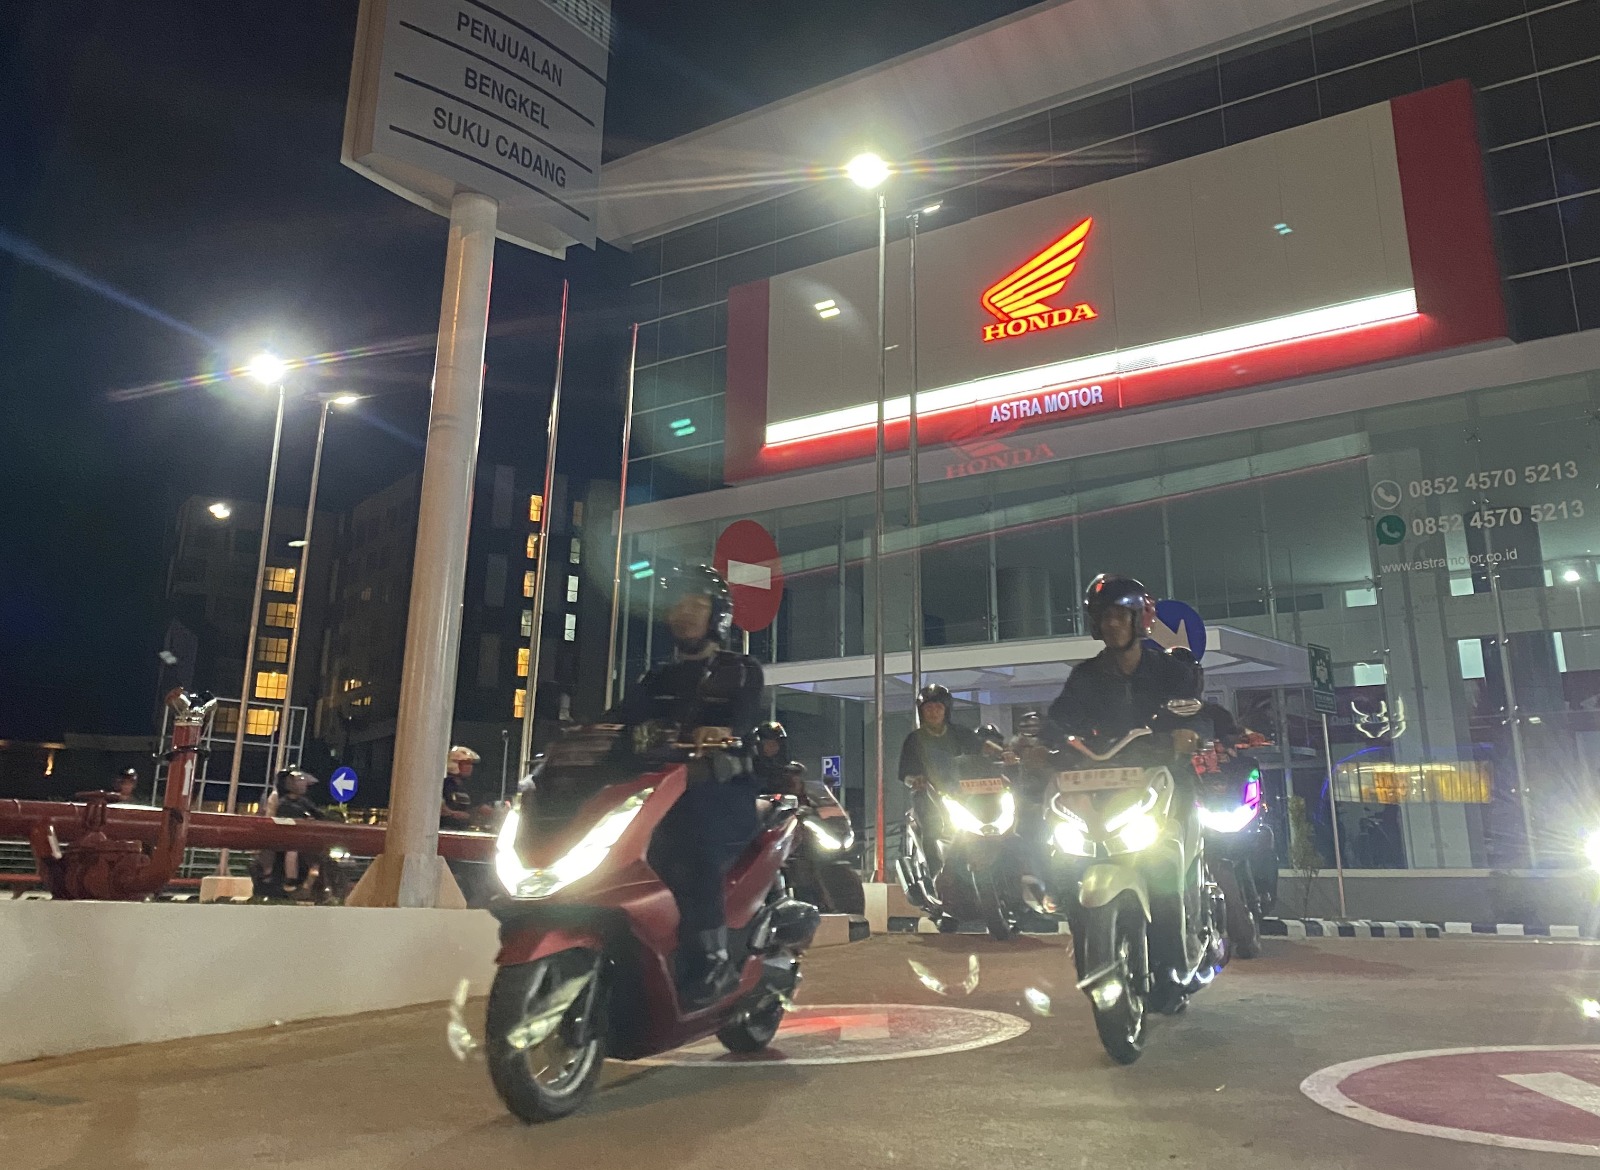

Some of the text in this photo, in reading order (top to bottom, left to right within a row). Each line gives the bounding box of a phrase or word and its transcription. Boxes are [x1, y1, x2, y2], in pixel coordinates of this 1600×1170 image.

[457, 11, 563, 87] PENJUALAN
[464, 67, 550, 130] BENGKEL
[433, 107, 566, 189] SUKU CADANG
[983, 303, 1098, 342] HONDA
[990, 385, 1103, 424] ASTRA MOTOR
[1408, 460, 1579, 498] 0852 4570 5213
[1412, 499, 1585, 536] 0852 4570 5213
[1381, 547, 1518, 573] www.astramotor.co.id
[823, 758, 833, 775] P
